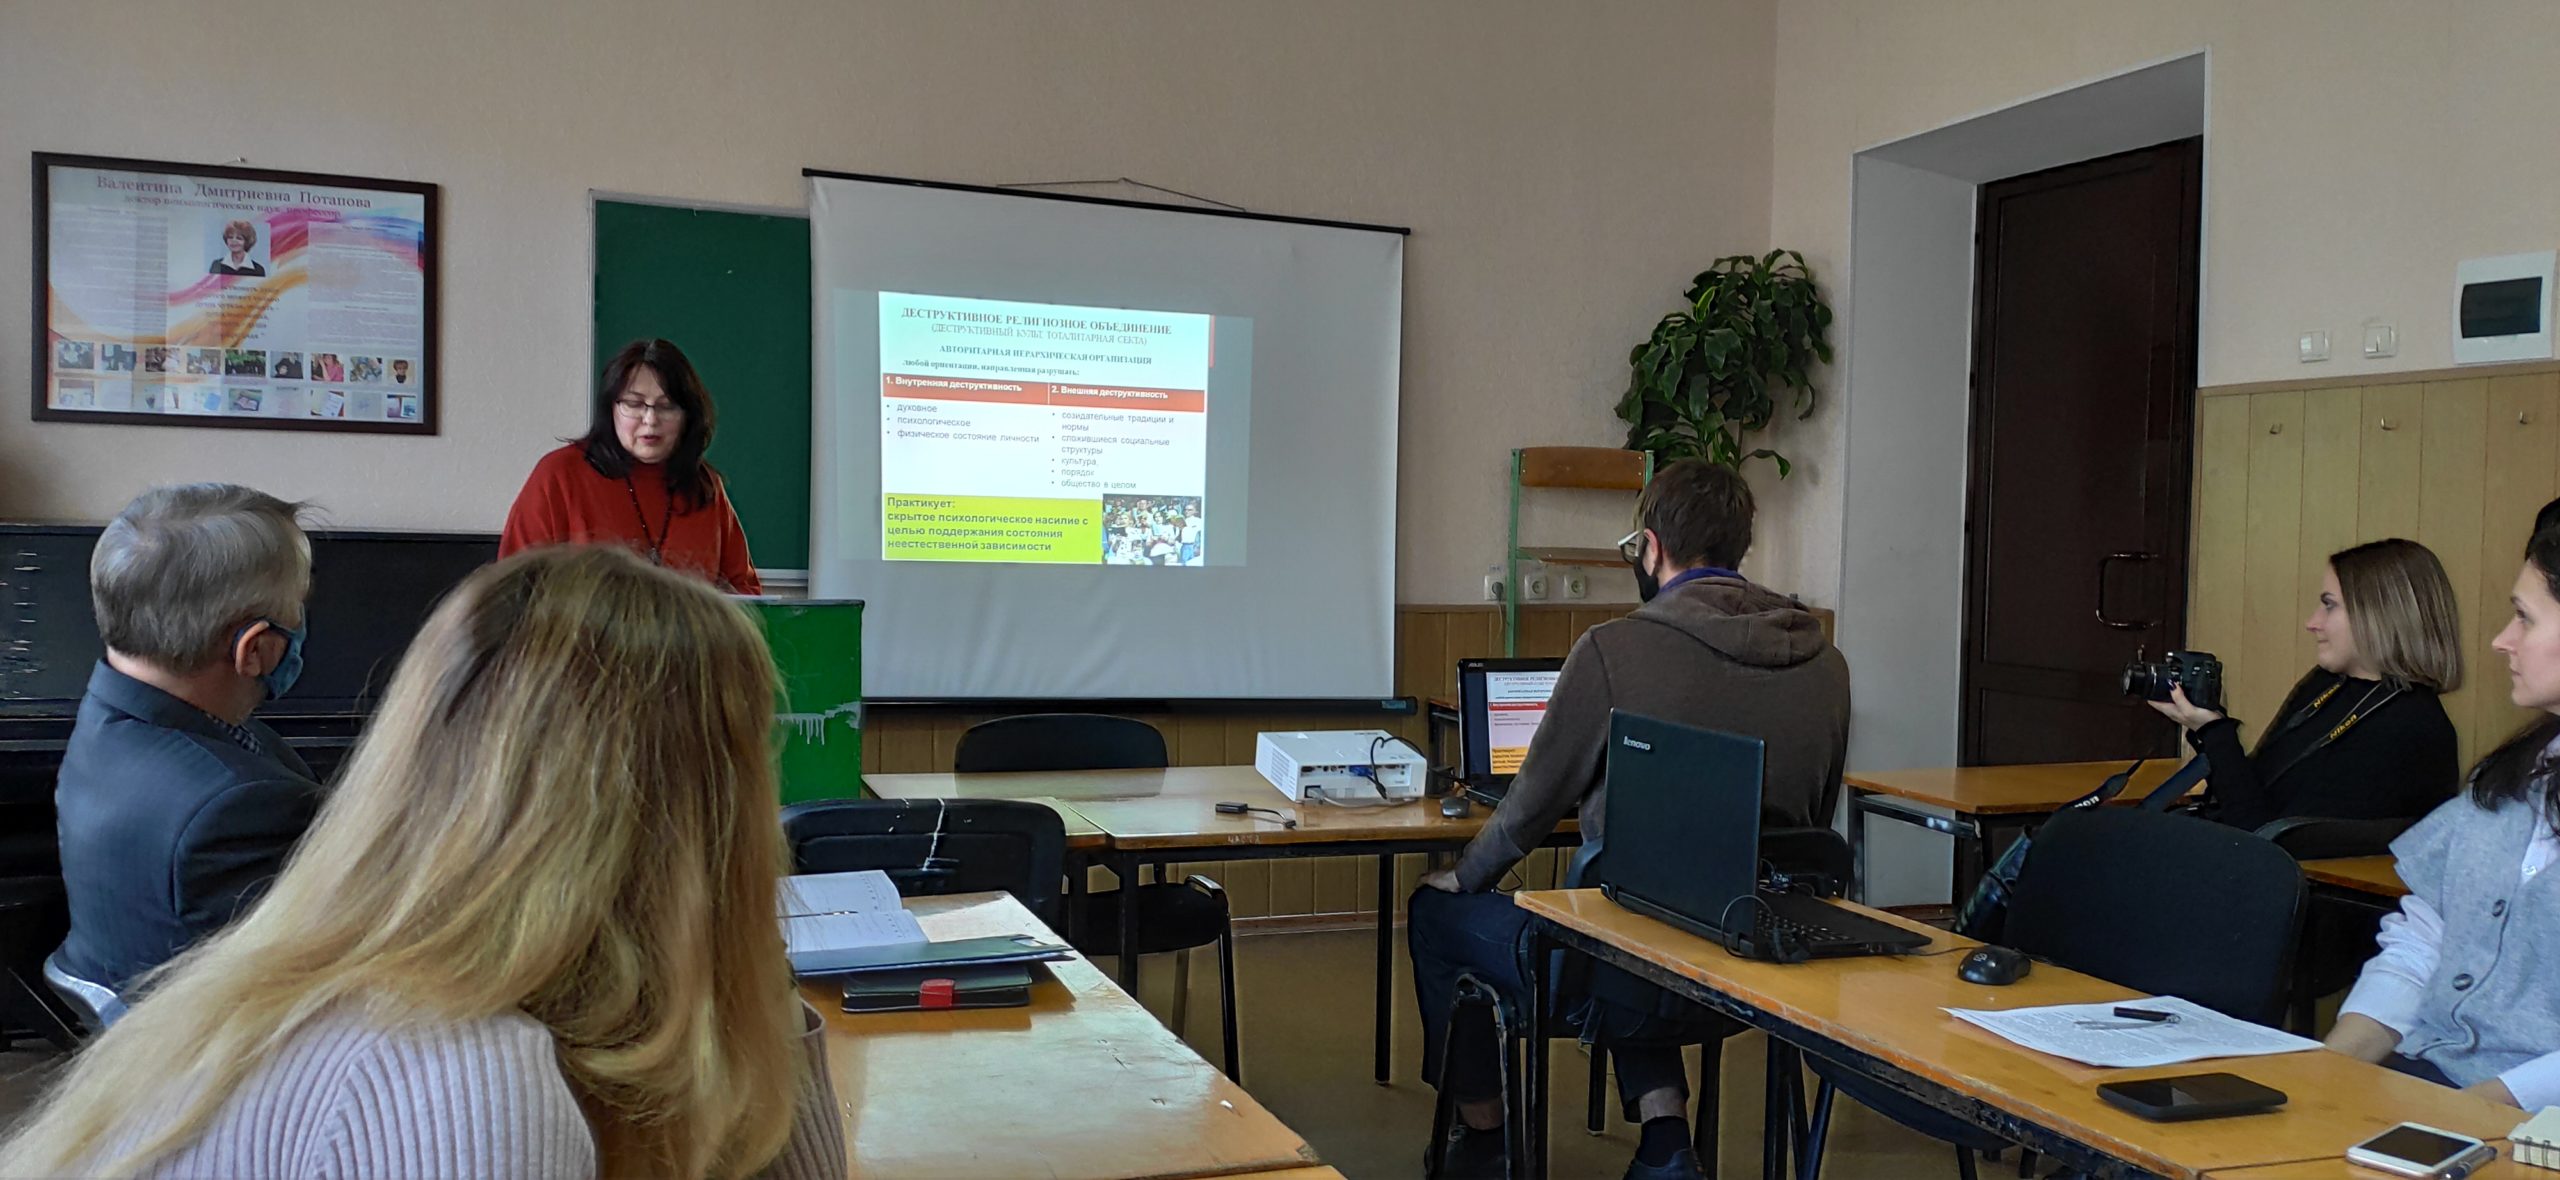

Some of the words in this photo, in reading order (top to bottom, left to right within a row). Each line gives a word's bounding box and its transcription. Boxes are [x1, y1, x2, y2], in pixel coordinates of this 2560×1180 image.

[97, 175, 183, 194] Валентина
[194, 183, 291, 203] Дмитриевна
[299, 191, 371, 208] Потапова
[901, 307, 1003, 324] ДЕСТРУКТИВНОЕ
[1006, 315, 1088, 330] РЕЛИГИОЗНОЕ
[1090, 321, 1172, 335] ОБЪЕДИНЕНИЕ
[931, 323, 1014, 337] (ДЕСТРУКТИВНЫЙ
[1047, 331, 1115, 343] ТОТАЛИТАРНАЯ
[1117, 335, 1148, 346] СЕКТА)
[939, 345, 1011, 356] АВТОРИТАРНАЯ
[1013, 349, 1088, 361] ИЕРАРХИЧЕСКАЯ
[1089, 354, 1152, 365] ОРГАНИЗАЦИЯ
[903, 359, 930, 367] любой
[981, 364, 1036, 374] направленная
[886, 376, 894, 385] 1.
[895, 376, 948, 389] Внутренняя
[949, 380, 1022, 393] деструктивность
[1051, 385, 1059, 394] 2.
[1061, 386, 1098, 395] Внешняя
[1099, 389, 1169, 400] деструктивность
[897, 403, 938, 413] духовное
[897, 416, 971, 427] психологическое
[1062, 412, 1124, 421] созидательные
[1128, 415, 1167, 424] традиции
[1062, 424, 1089, 432] нормы
[897, 429, 950, 440] физическое
[953, 432, 997, 441] состояние
[1000, 435, 1040, 443] личности
[1062, 435, 1117, 444] сложившиеся
[1121, 438, 1170, 447] социальные
[1062, 446, 1103, 455] структуры
[1062, 469, 1095, 478] порядок
[1062, 479, 1101, 489] общество
[1111, 482, 1137, 490] целом
[887, 496, 956, 509] Практикует:
[887, 513, 936, 524] скрытое
[938, 513, 1033, 524] психологическое
[1035, 517, 1080, 526] насилие
[1082, 518, 1089, 526] с
[887, 527, 926, 537] целью
[928, 528, 1004, 538] поддержания
[1006, 530, 1063, 539] состояния
[887, 540, 979, 550] неестественной
[980, 543, 1052, 552] зависимости
[2313, 683, 2341, 708] Nikon
[2330, 713, 2358, 740] Nikon
[1623, 735, 1651, 751] lenovo
